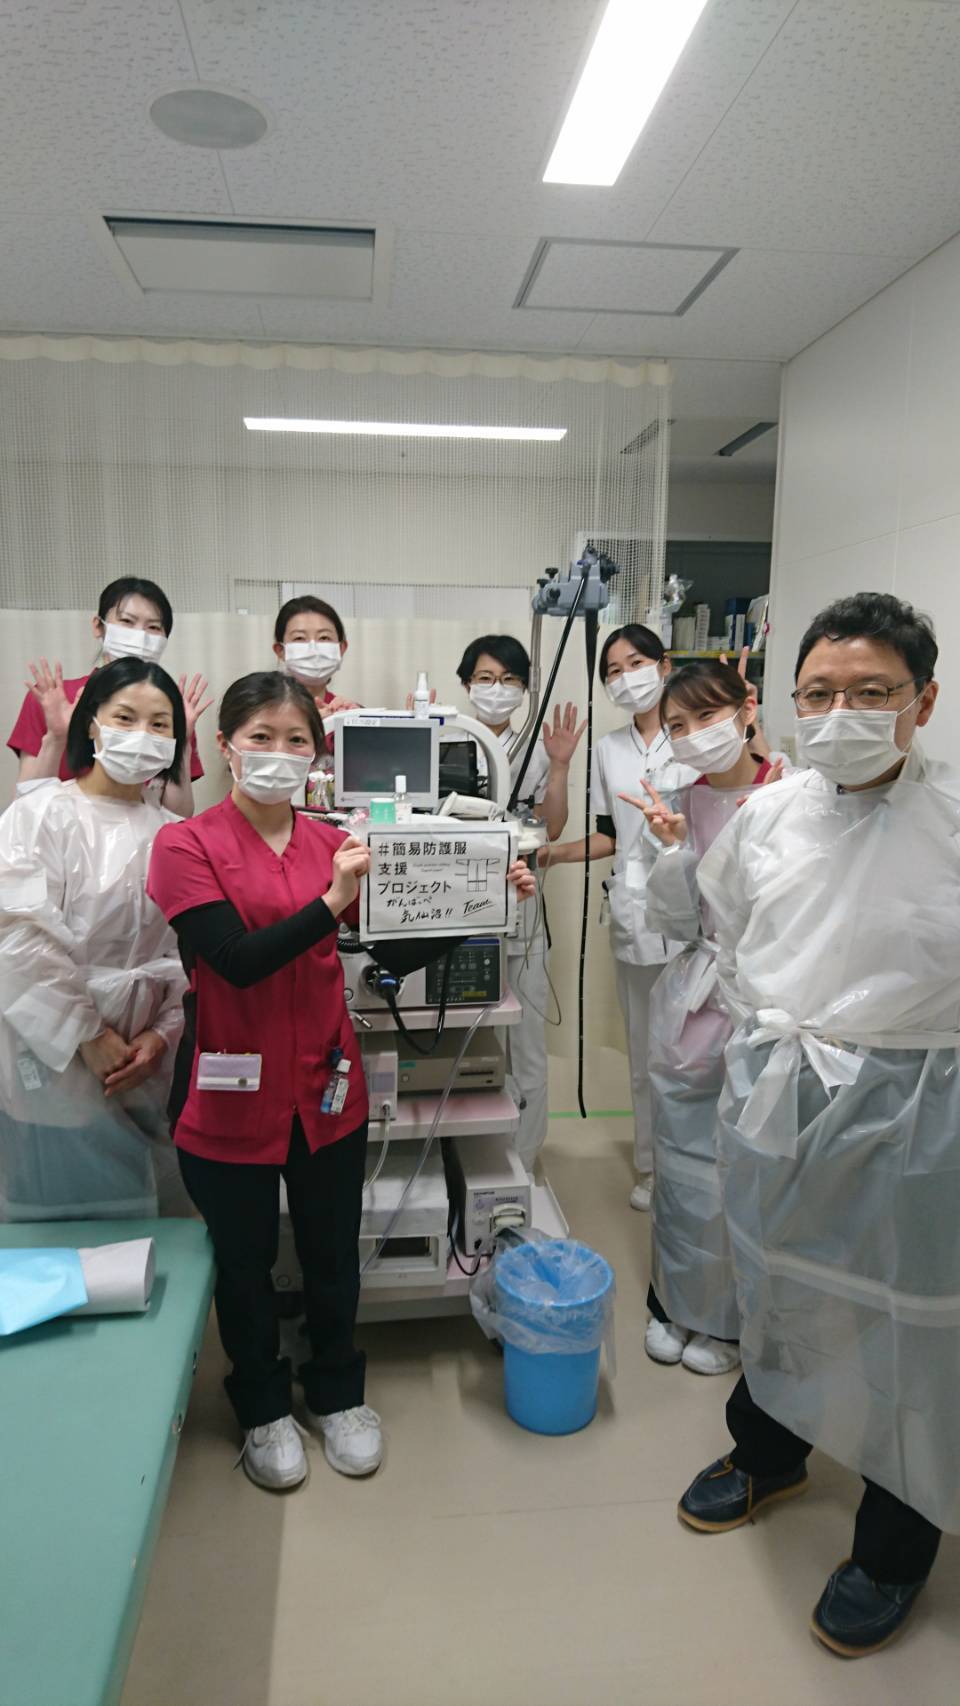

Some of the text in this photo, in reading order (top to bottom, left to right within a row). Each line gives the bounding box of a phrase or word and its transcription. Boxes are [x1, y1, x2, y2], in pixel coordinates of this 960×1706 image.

[378, 841, 467, 857] #簡易防護服
[378, 862, 408, 876] 支援
[378, 880, 452, 895] プロジェクト
